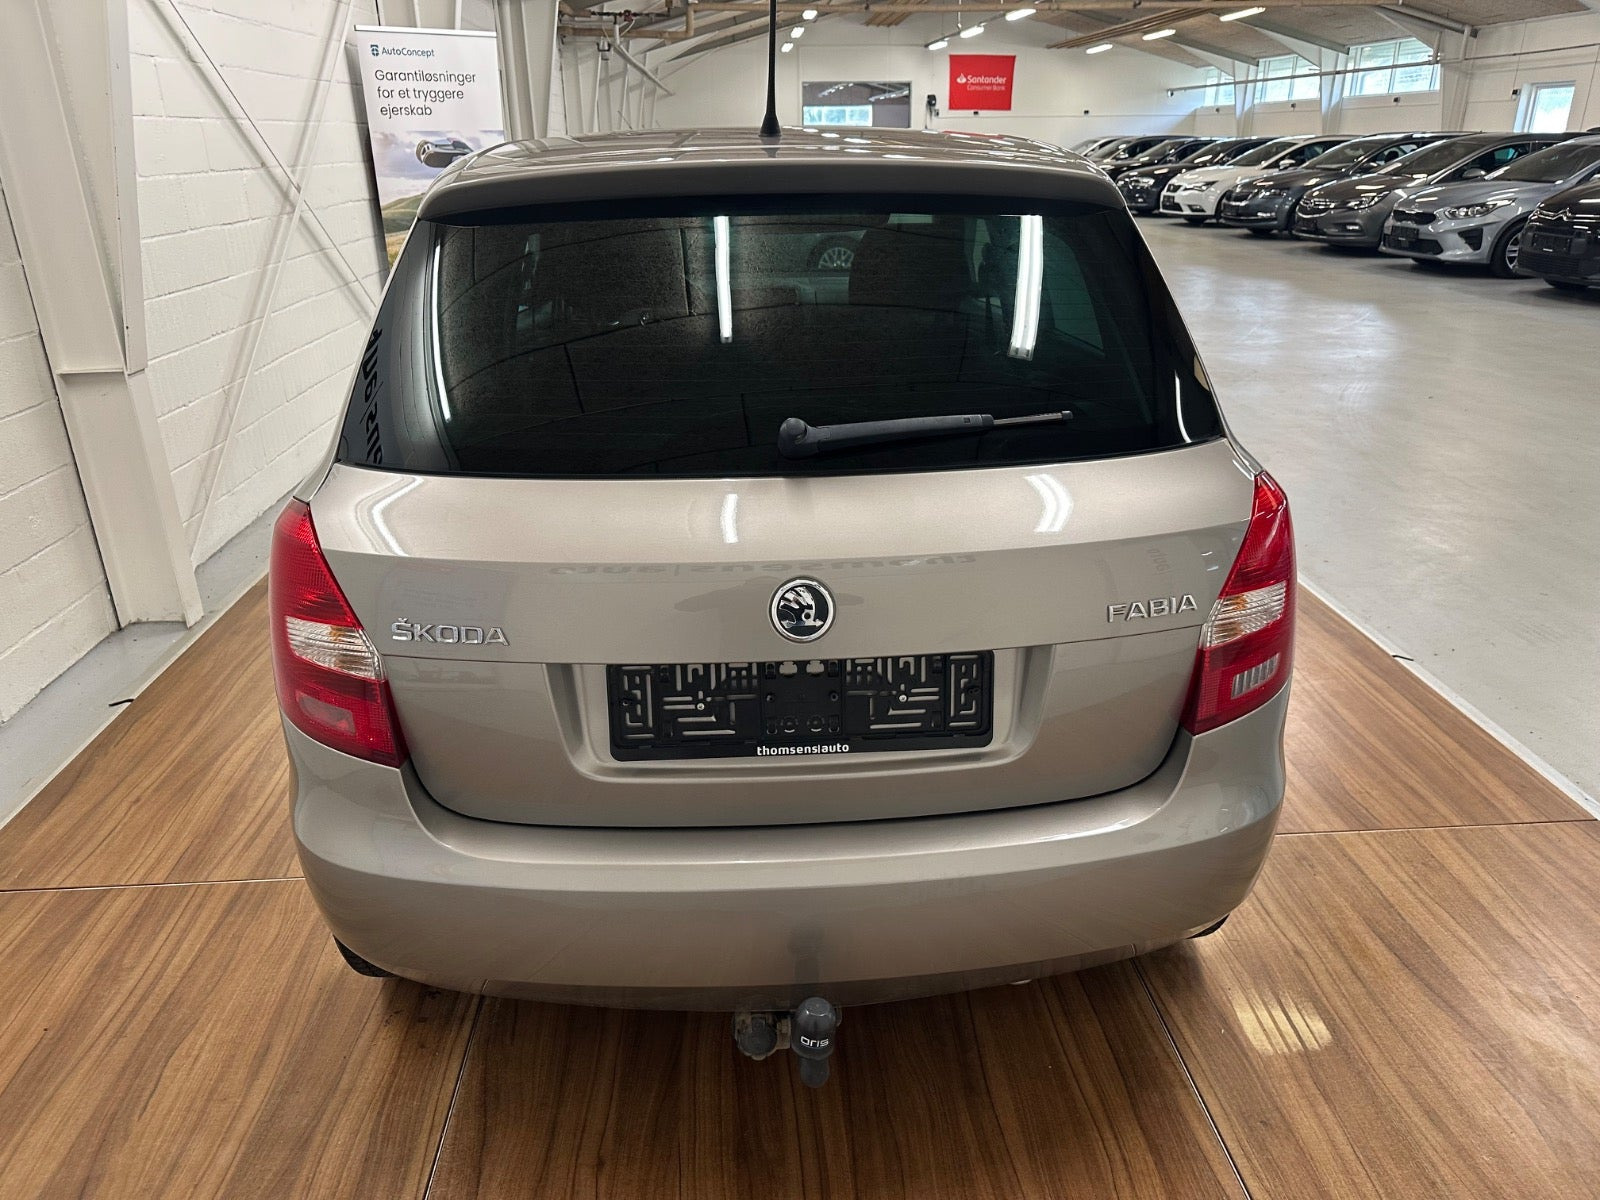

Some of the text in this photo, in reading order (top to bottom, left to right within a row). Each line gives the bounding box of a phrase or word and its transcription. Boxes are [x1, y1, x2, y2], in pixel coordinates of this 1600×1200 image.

[381, 46, 435, 59] AutoConcept
[374, 69, 476, 86] Garantiløsninger
[967, 74, 1007, 84] Santander
[377, 86, 464, 102] for et tryggere
[380, 104, 433, 119] ejerskab
[1107, 594, 1198, 623] FABIA
[391, 617, 510, 646] ŠKODA
